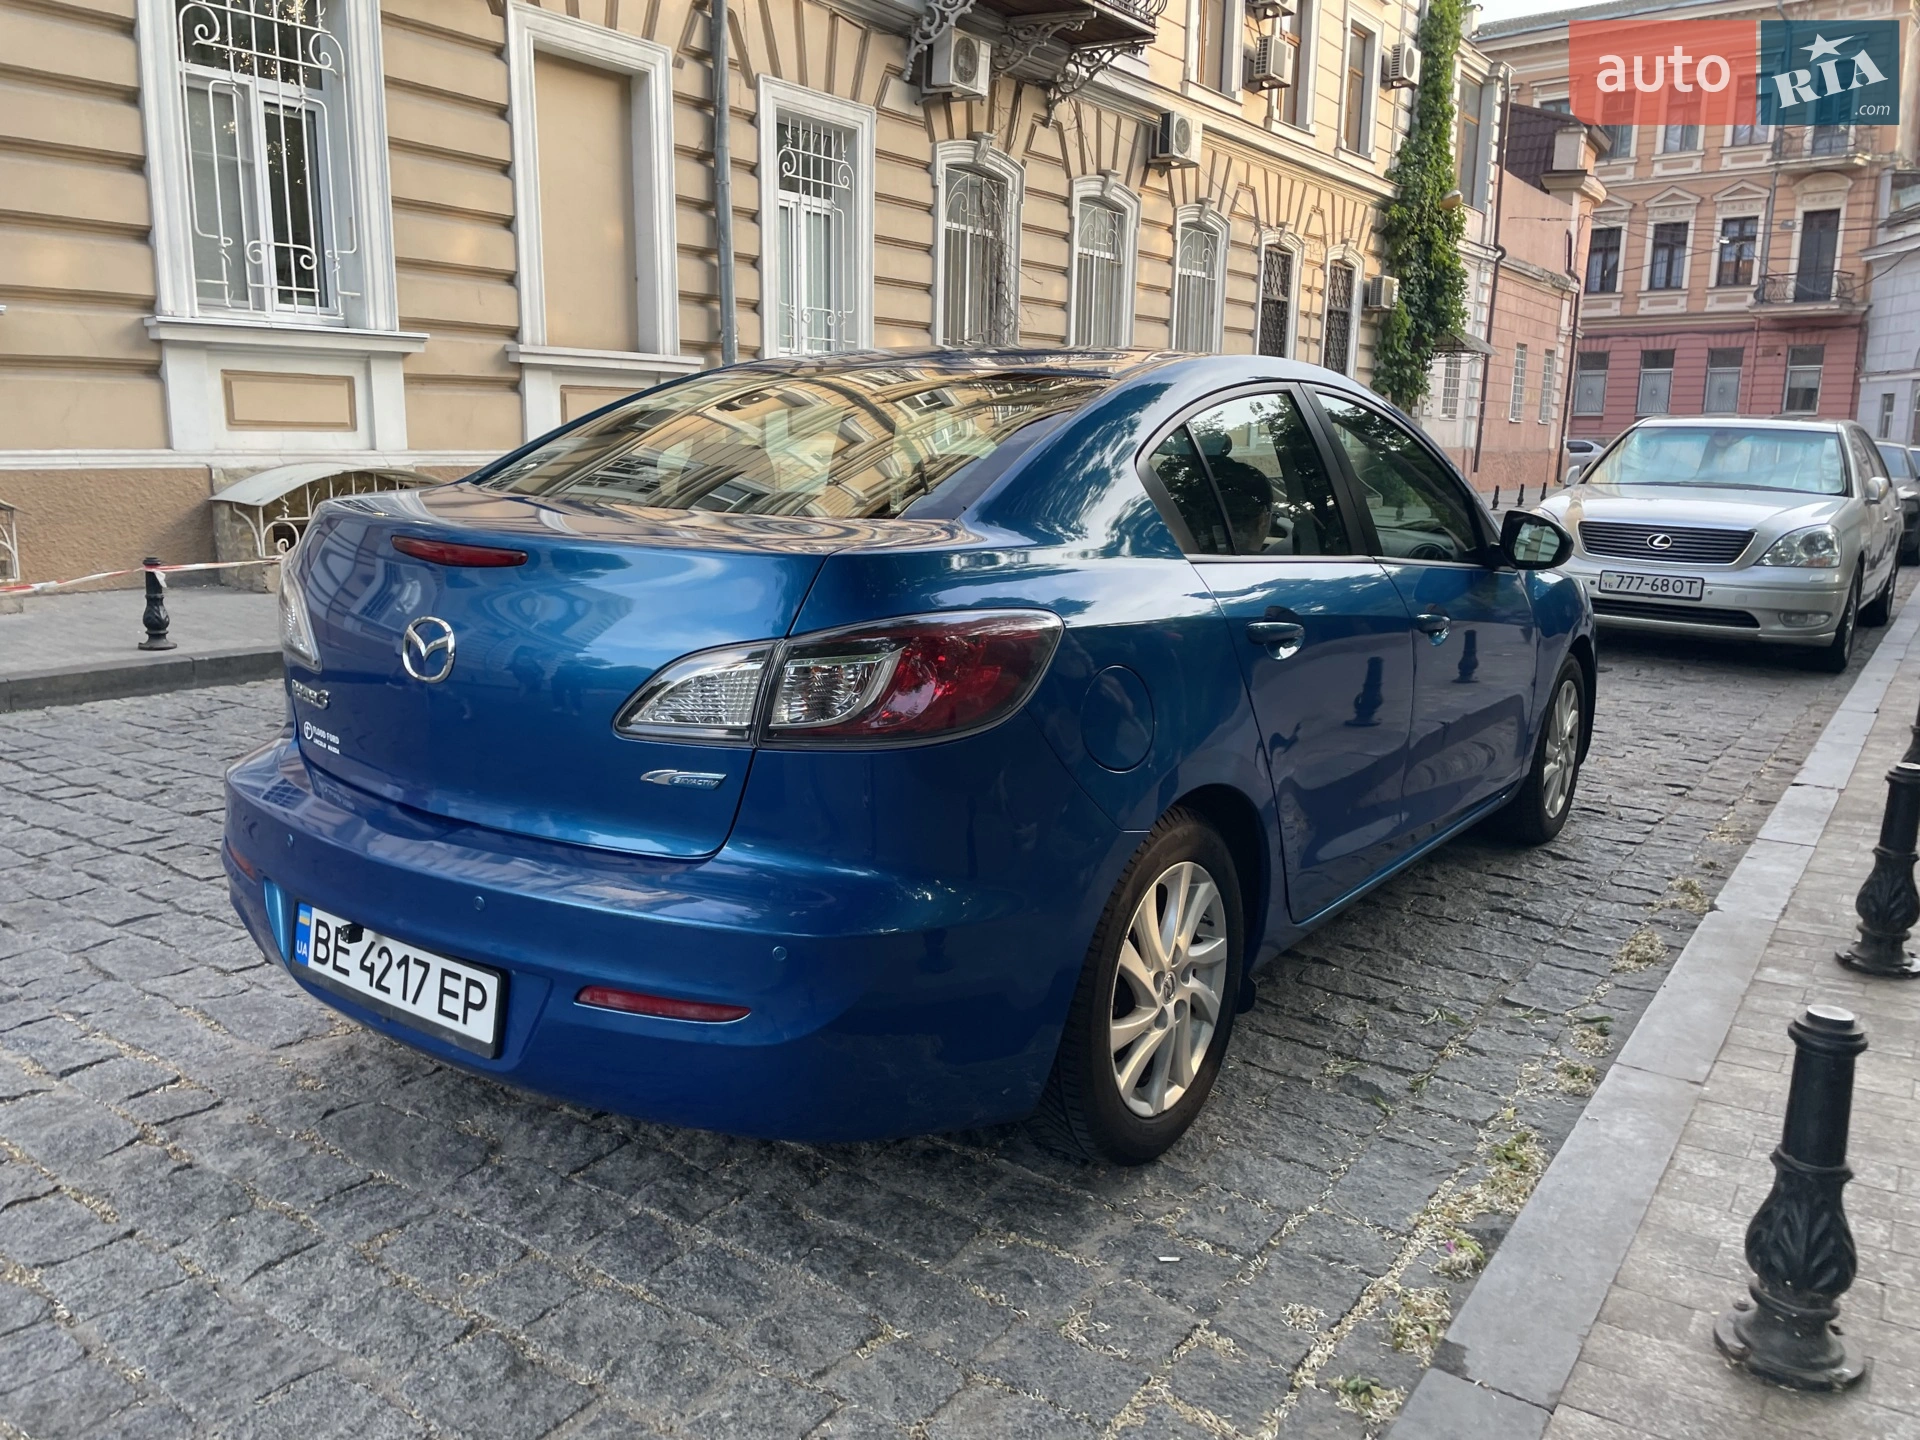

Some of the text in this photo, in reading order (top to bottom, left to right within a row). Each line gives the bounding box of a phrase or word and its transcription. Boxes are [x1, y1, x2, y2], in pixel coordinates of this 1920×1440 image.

[673, 777, 719, 787] SKYACTIV
[296, 939, 307, 956] UA
[313, 918, 487, 1025] BE 4217 EP
